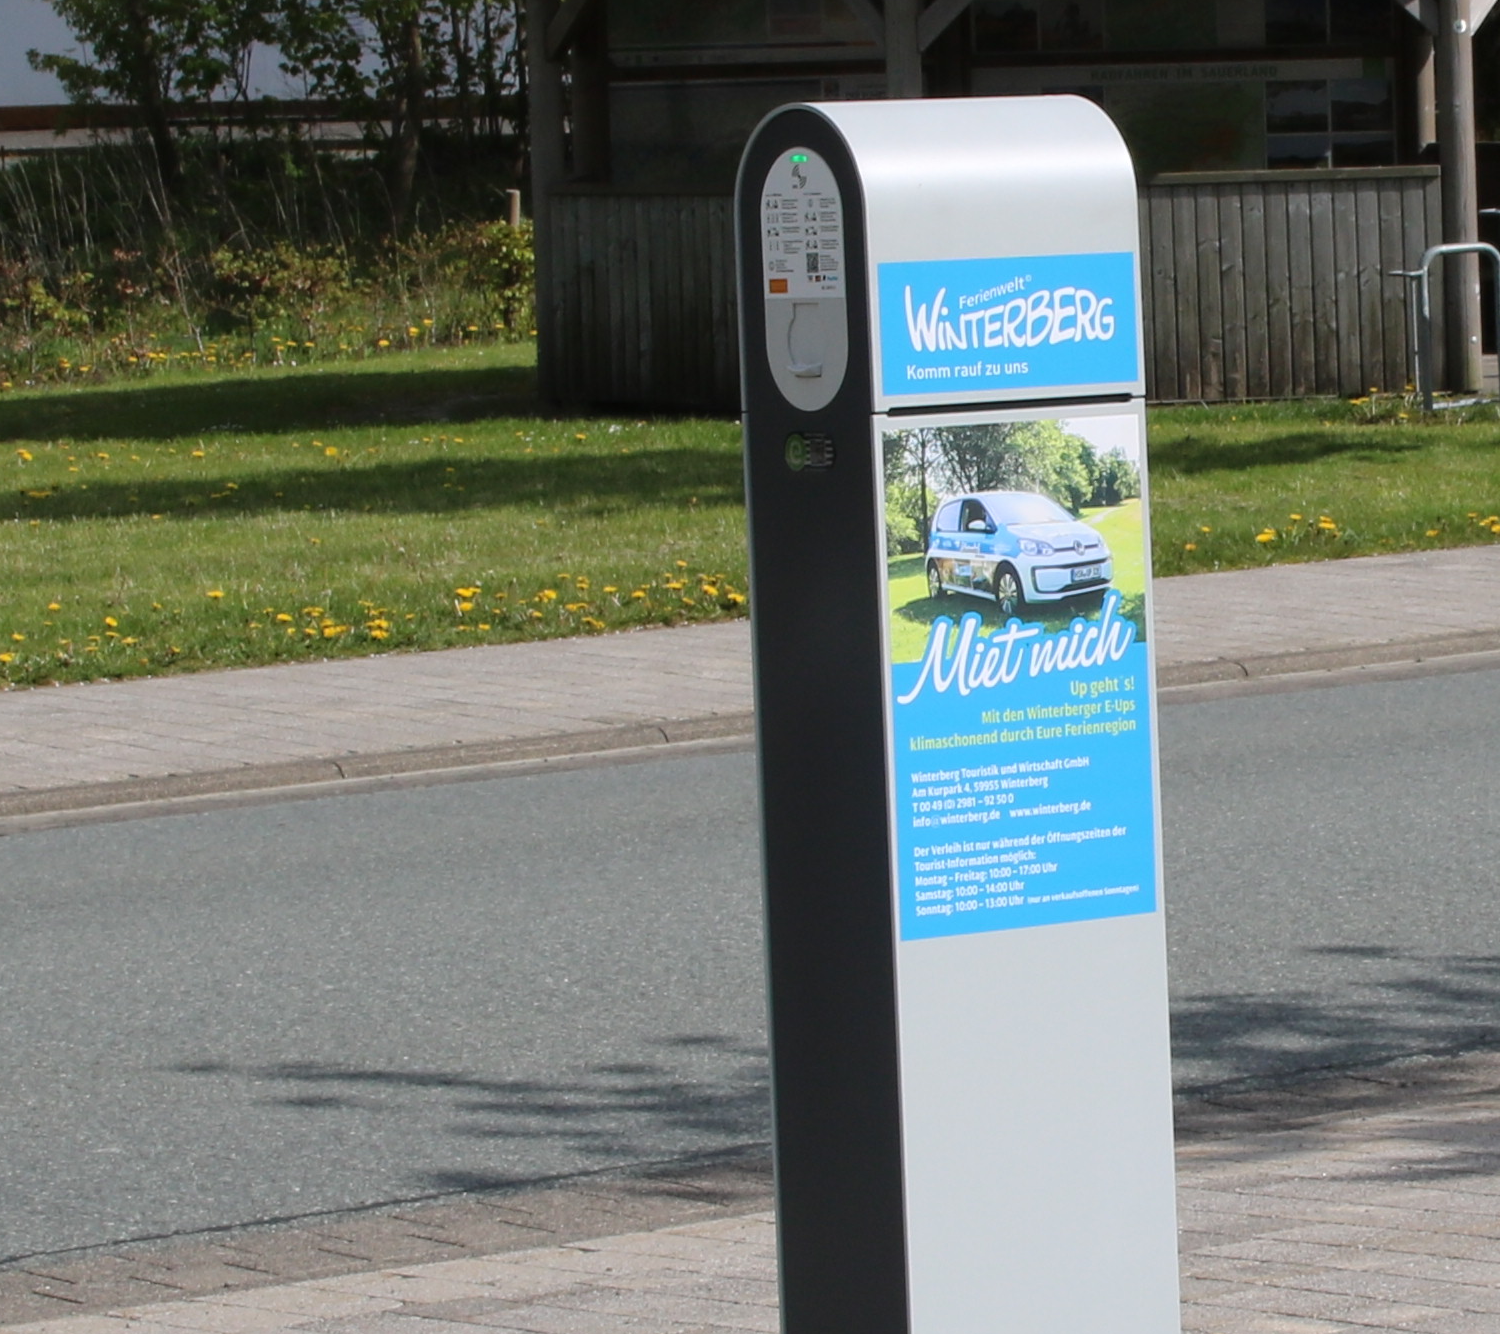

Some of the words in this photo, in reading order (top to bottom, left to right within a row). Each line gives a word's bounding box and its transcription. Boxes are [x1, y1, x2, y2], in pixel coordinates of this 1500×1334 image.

[1177, 67, 1193, 79] IM
[1201, 65, 1278, 79] SAUERLAND
[906, 365, 951, 380] Komm
[954, 360, 983, 378] rauf
[985, 363, 1001, 377] zu
[1004, 361, 1029, 376] uns
[897, 618, 1040, 705] Miet
[1029, 593, 1134, 677] mich
[1070, 680, 1088, 699] Up
[982, 709, 1001, 724] Mit
[1003, 708, 1025, 723] den
[1027, 702, 1102, 720] Winterberger
[1105, 699, 1136, 715] E-Ups
[910, 729, 998, 751] klimaschonend
[1000, 726, 1034, 743] durch
[1037, 725, 1063, 739] Eure
[1065, 717, 1137, 737] Ferienregion
[911, 770, 960, 783] Winterberg
[961, 764, 999, 779] Touristik
[1001, 763, 1018, 775] und
[1019, 758, 1063, 773] Wirtschaft
[1064, 756, 1090, 769] GmbH
[912, 788, 927, 798] Am
[928, 783, 963, 797] Kurpark
[974, 779, 1000, 793] 59955
[1001, 776, 1049, 789] Winterberg
[913, 809, 1001, 827] info@winterberg.de
[1010, 800, 1092, 818] www.winterberg.de
[932, 799, 943, 811] 49
[957, 797, 977, 809] 2981
[984, 795, 996, 806] 92
[996, 793, 1007, 805] 50
[1008, 793, 1015, 804] 0
[914, 846, 930, 858] Der
[931, 842, 962, 855] Verleih
[963, 841, 975, 853] ist
[976, 841, 991, 851] nur
[992, 835, 1030, 849] während
[1031, 834, 1046, 845] der
[1047, 827, 1112, 843] Öffnungszeiten
[1113, 825, 1127, 837] der
[915, 853, 999, 872] Tourist-Information
[1000, 849, 1037, 865] möglich:
[915, 875, 948, 887] Montag
[955, 870, 988, 883] Freitag:
[989, 866, 1012, 879] 10:00
[1019, 863, 1042, 875] 17:00
[1043, 862, 1058, 873] Uhr
[916, 889, 955, 902] Samstag:
[956, 885, 978, 897] 10:00
[986, 881, 1008, 893] 14:00
[1009, 880, 1025, 892] Uhr
[916, 903, 955, 917] Sonntag:
[956, 899, 978, 912] 10:00
[986, 896, 1008, 909] 13:00
[1009, 895, 1025, 907] Uhr
